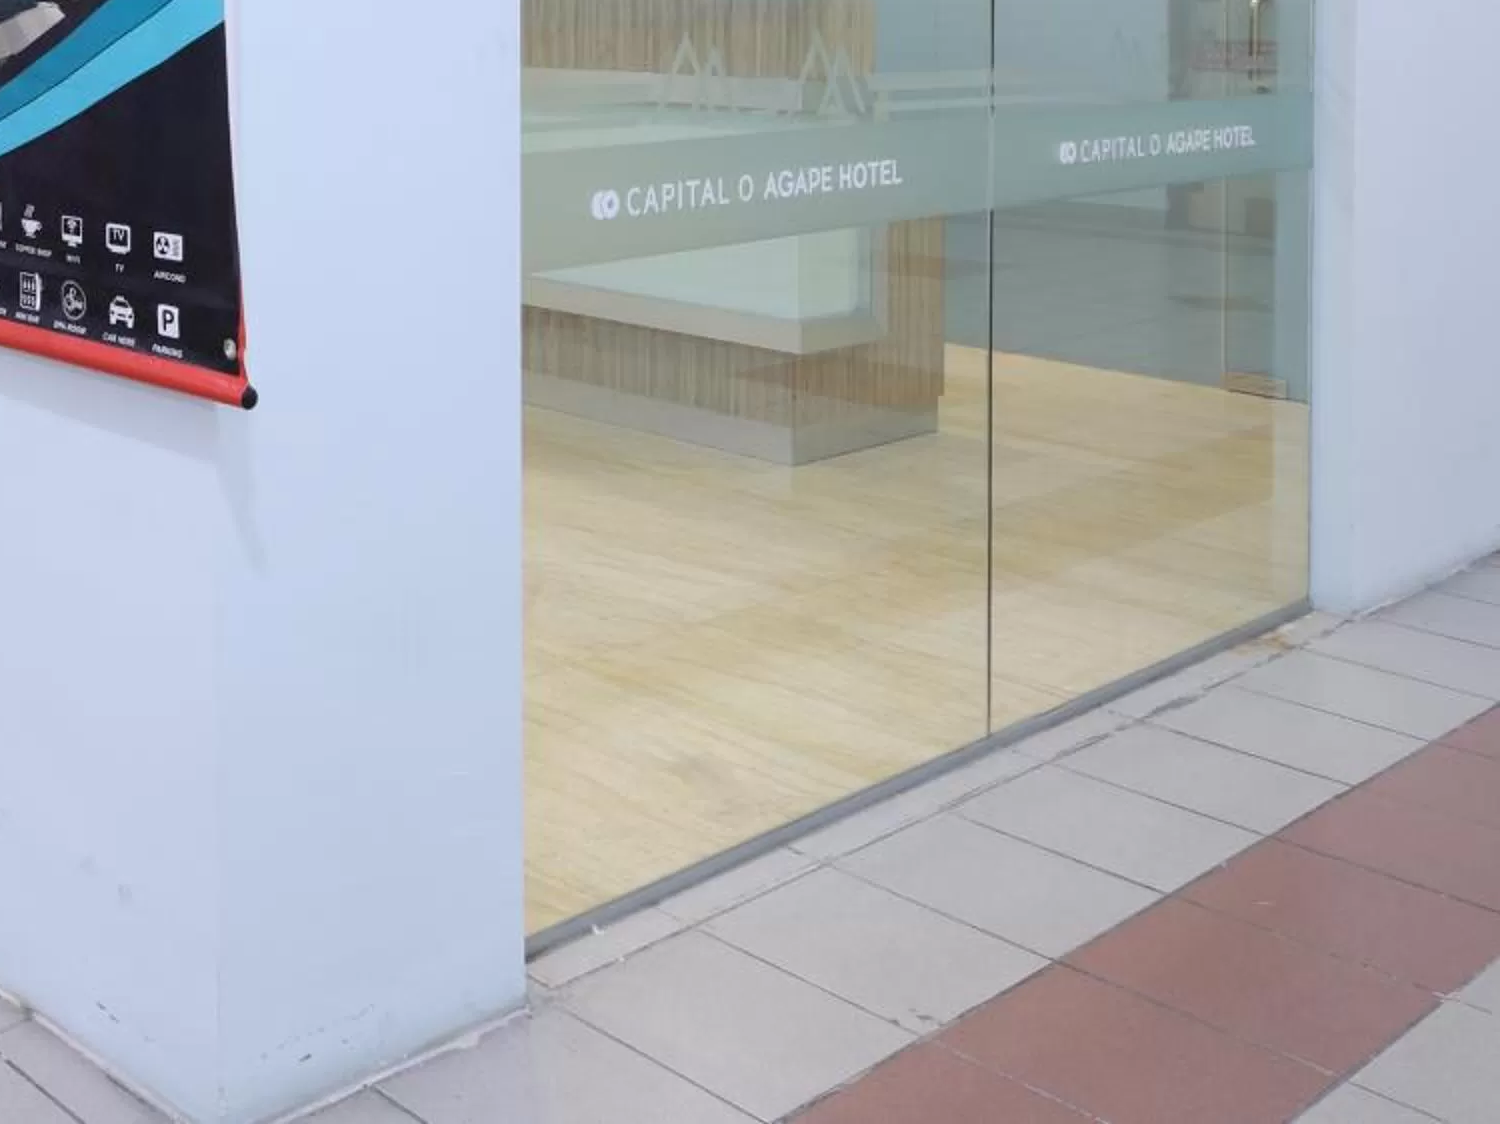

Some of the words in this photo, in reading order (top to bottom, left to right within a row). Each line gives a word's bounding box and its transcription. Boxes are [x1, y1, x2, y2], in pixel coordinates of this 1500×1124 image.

[1080, 136, 1145, 164] CAPITAL
[1166, 129, 1211, 154] AGAPE
[1213, 126, 1256, 149] HOTEL
[626, 177, 731, 217] CAPITAL
[739, 174, 754, 202] O
[763, 166, 833, 200] AGAPE
[838, 159, 903, 190] HOTEL
